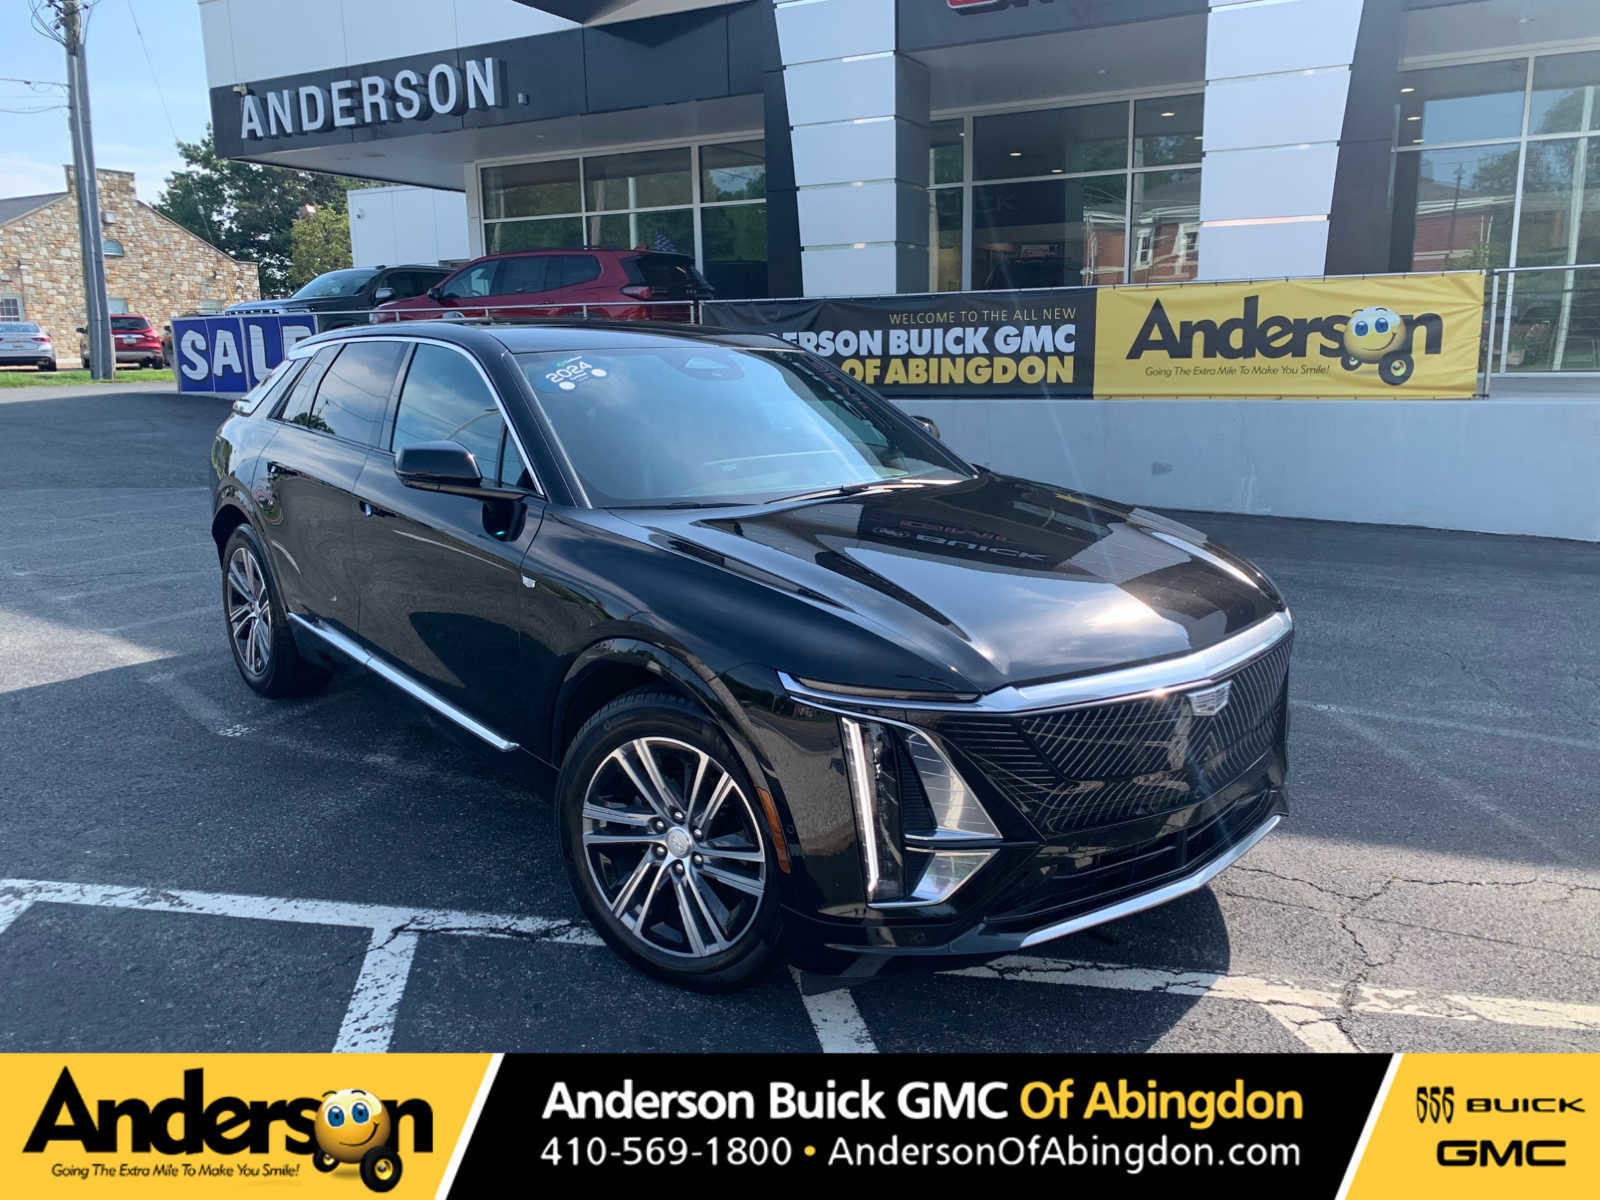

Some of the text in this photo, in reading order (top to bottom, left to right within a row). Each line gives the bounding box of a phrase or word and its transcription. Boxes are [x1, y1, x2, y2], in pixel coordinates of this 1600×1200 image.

[240, 57, 497, 139] ANDERSON
[889, 307, 1077, 325] WELCOME TO THE ALL NEW
[889, 326, 990, 356] BUICK
[994, 323, 1076, 354] GMC
[545, 361, 592, 384] 2024
[840, 355, 1075, 384] OF ABINGDON
[1145, 363, 1330, 378] Going The Extra Mile To Make You Smile!
